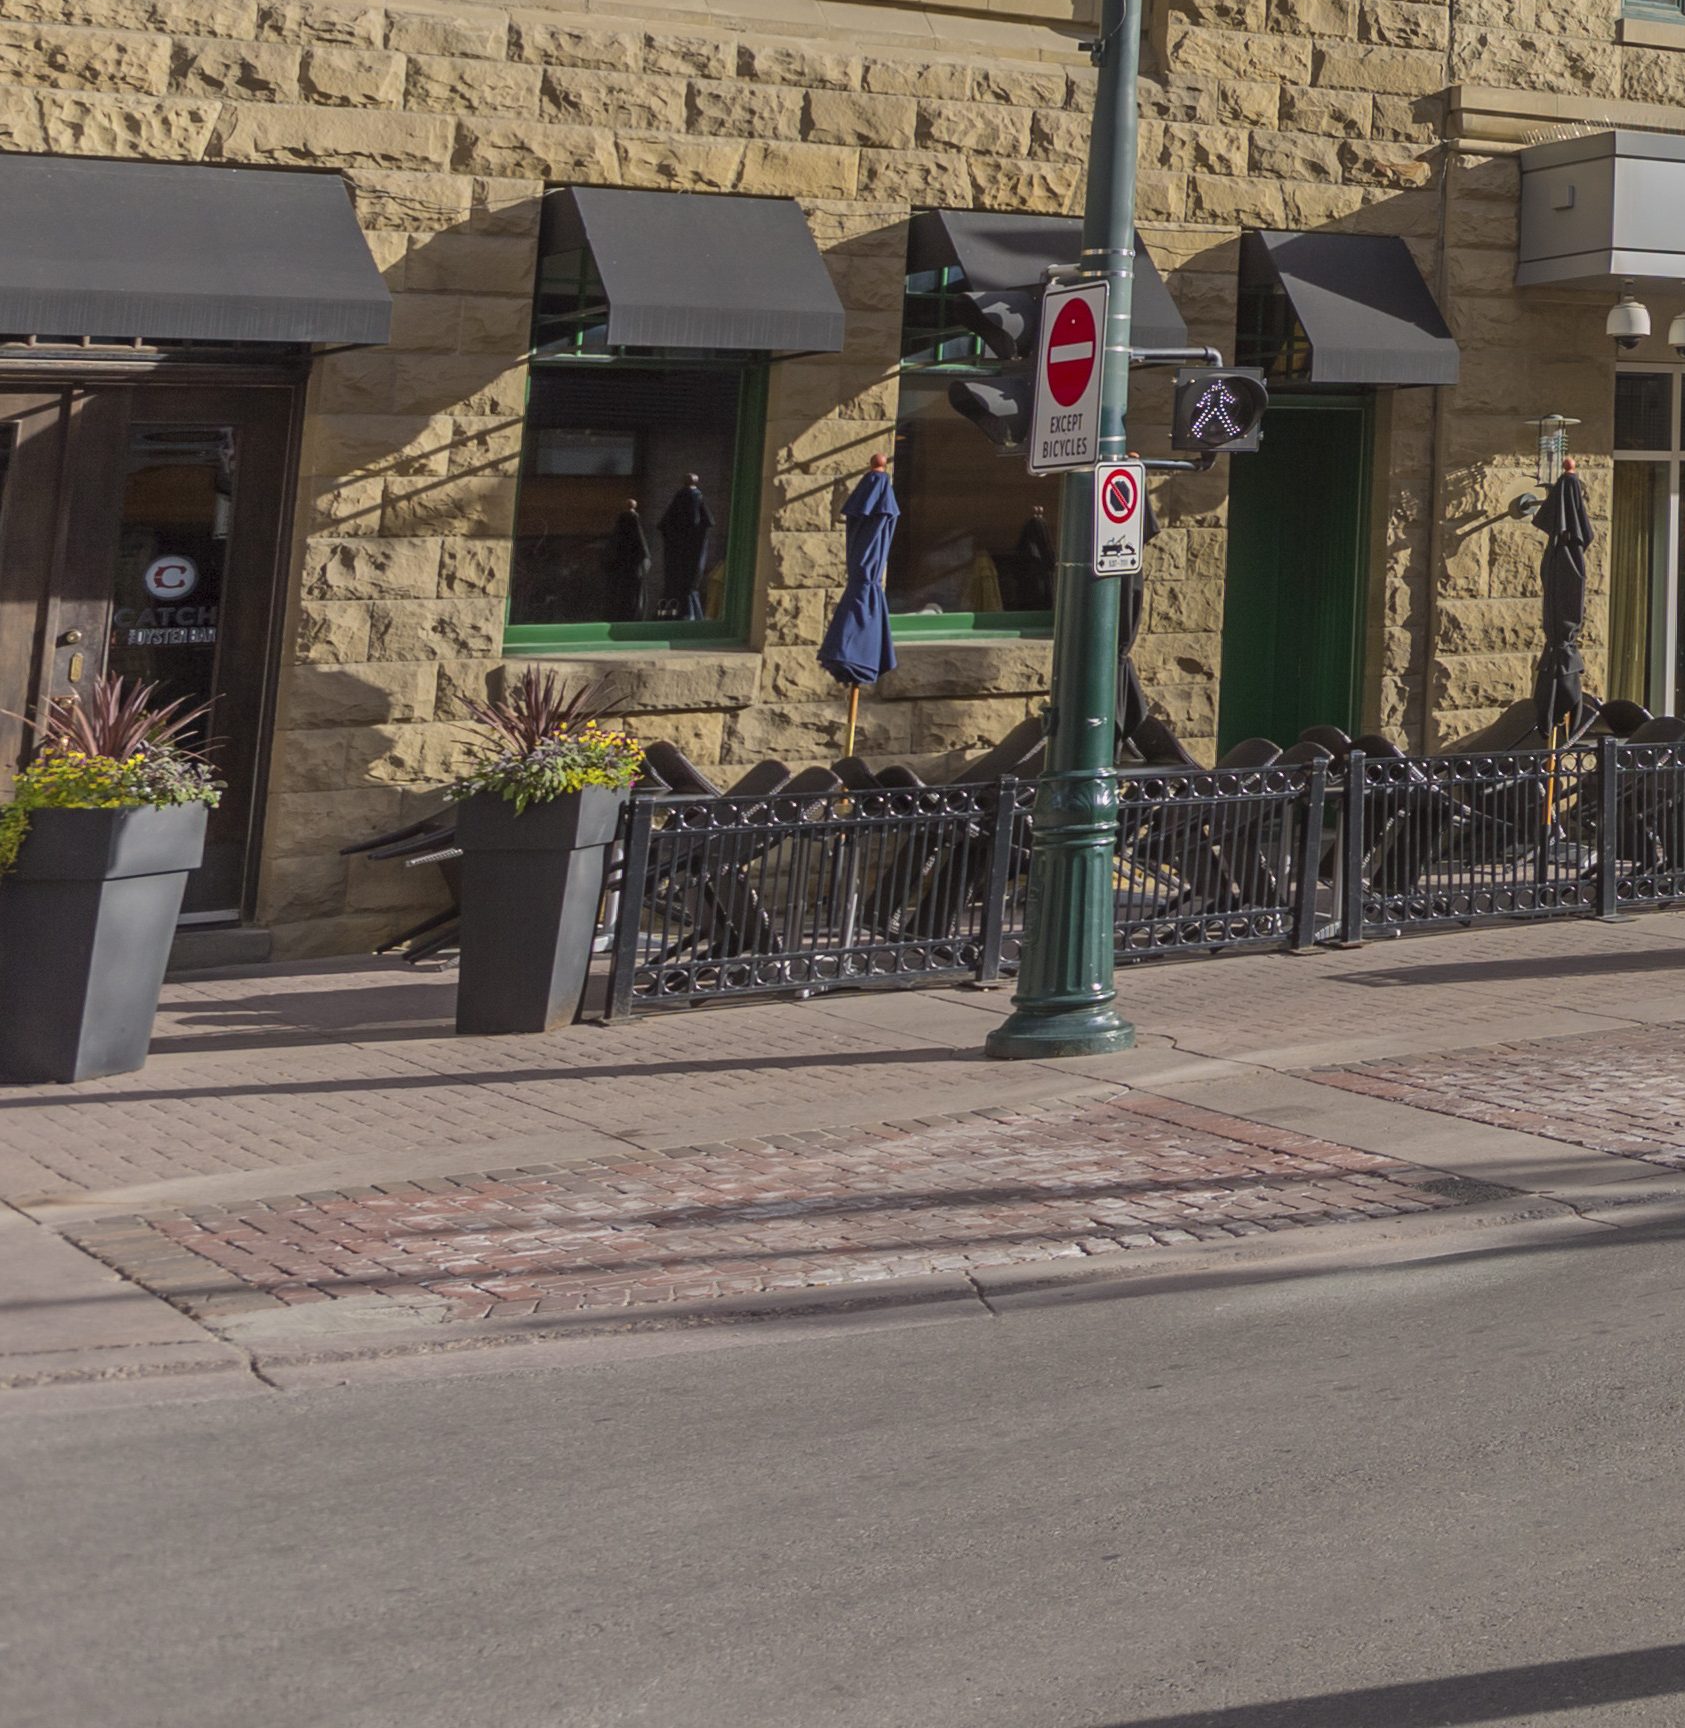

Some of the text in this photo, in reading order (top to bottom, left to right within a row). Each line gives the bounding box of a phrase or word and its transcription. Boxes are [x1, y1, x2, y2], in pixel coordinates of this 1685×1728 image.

[1050, 413, 1083, 434] EXCEPT
[1042, 436, 1087, 459] BICYCLES
[113, 606, 217, 628] CATCH
